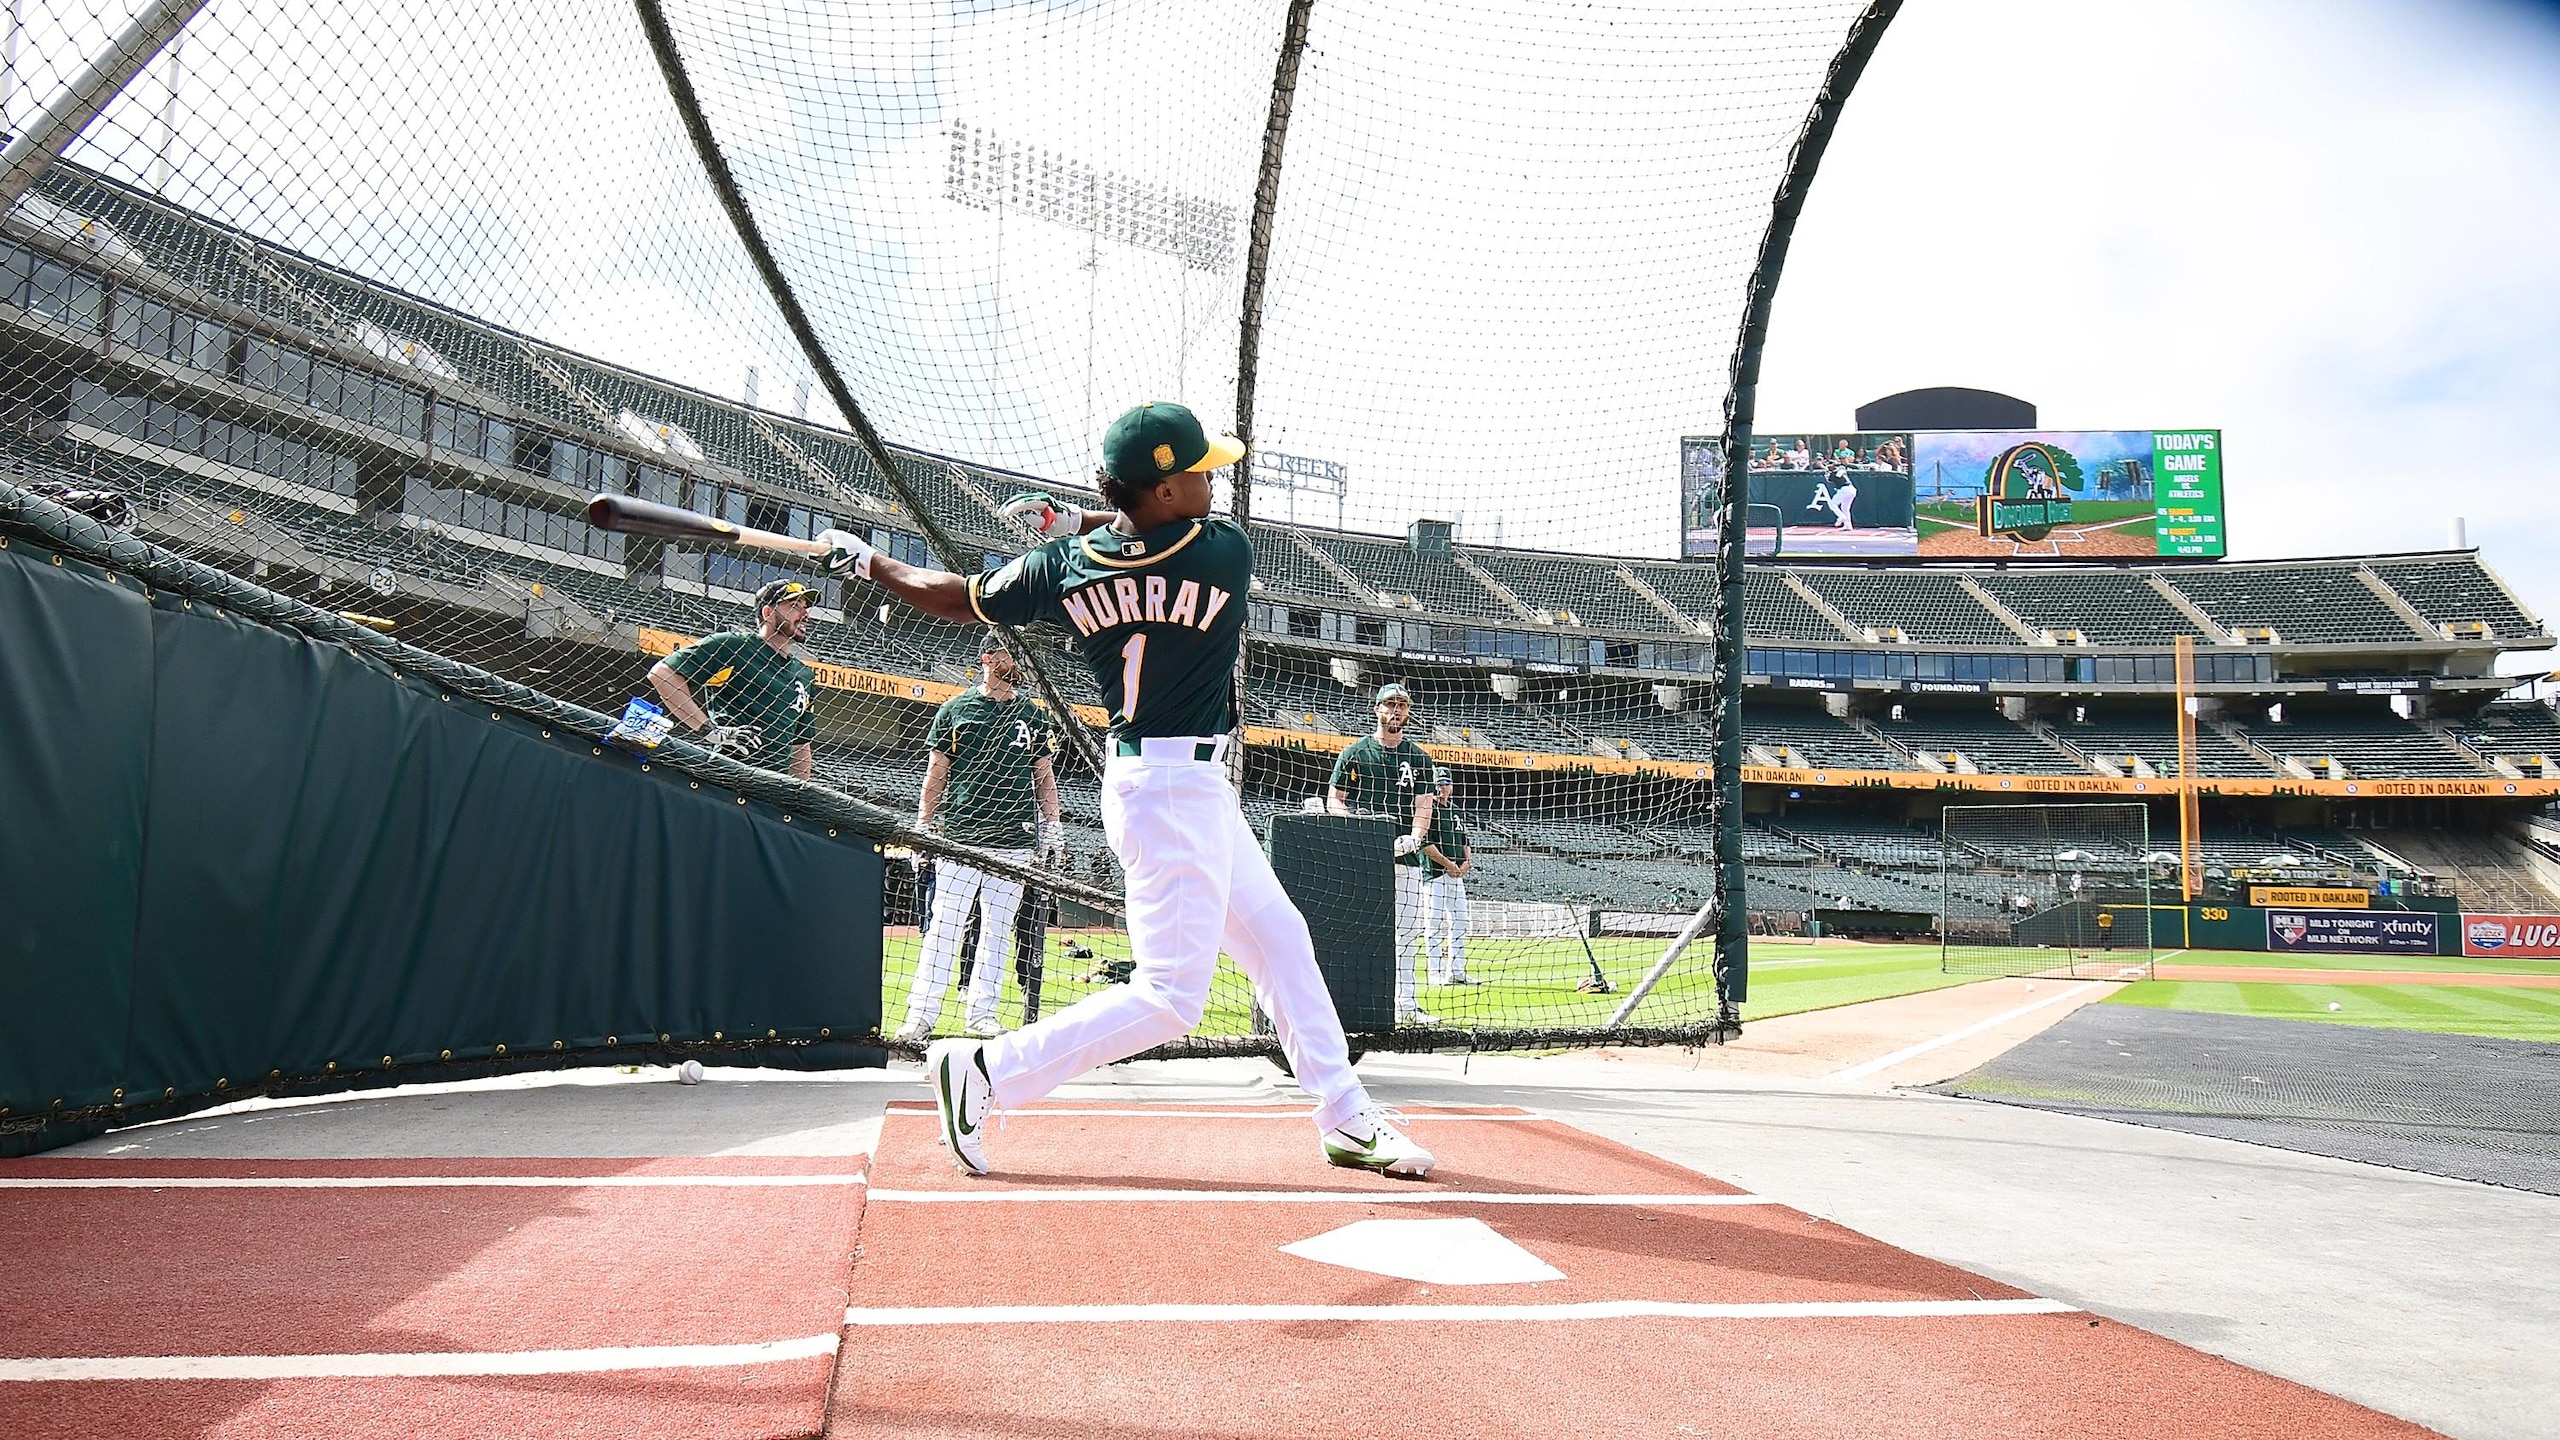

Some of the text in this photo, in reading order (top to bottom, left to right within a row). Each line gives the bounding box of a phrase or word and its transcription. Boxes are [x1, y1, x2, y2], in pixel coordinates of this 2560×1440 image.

[2154, 434, 2215, 450] TODAY'S
[1262, 451, 1341, 480] CREEK
[2164, 455, 2206, 471] GAME
[1250, 474, 1294, 492] ESORT
[2168, 490, 2205, 498] ATHLETICS
[374, 572, 392, 590] 24
[1062, 575, 1231, 638] MURRAY
[1401, 652, 1426, 660] FOLLOW
[849, 673, 899, 695] OAKLAN
[1121, 632, 1147, 723] 1
[1922, 684, 1980, 693] FOUNDATION
[1431, 749, 1460, 761] OOTED
[1462, 751, 1473, 763] IN
[1752, 770, 1763, 780] IN
[1766, 771, 1805, 782] OAKLAN
[2024, 780, 2122, 791] OOTED IN OAKLAN
[2374, 783, 2490, 794] OOTED IN OAKLAN
[2271, 893, 2364, 904] ROOTED IN OAKLAND
[2201, 908, 2228, 920] 330
[2309, 919, 2376, 929] MLB TONIGHT
[2383, 920, 2432, 935] xfinity
[2307, 935, 2327, 943] MLB
[2329, 936, 2379, 945] NETWORK
